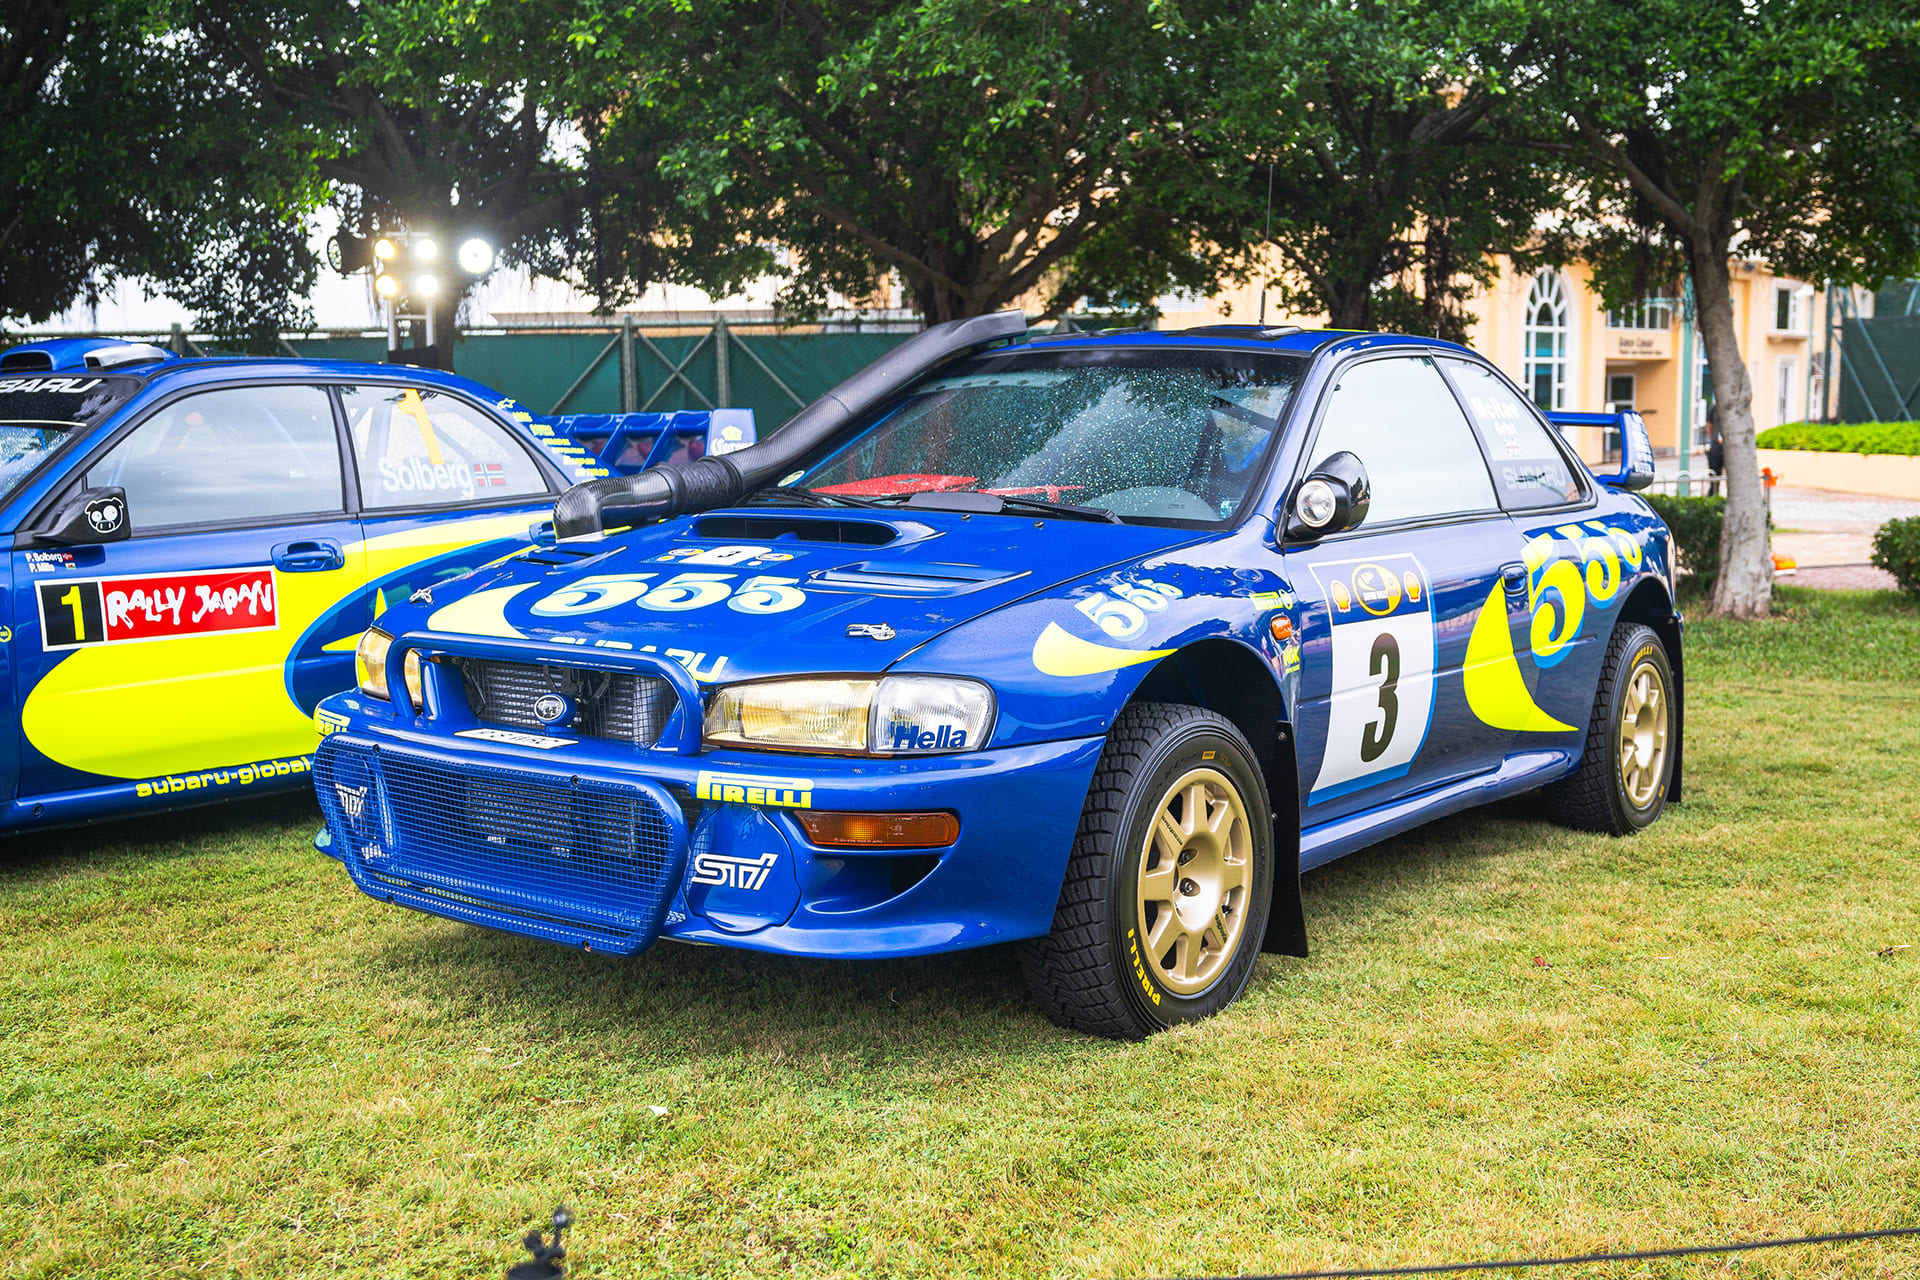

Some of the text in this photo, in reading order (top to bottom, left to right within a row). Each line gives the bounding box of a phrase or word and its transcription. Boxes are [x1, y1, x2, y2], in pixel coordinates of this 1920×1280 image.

[397, 388, 444, 465] 1
[379, 456, 475, 499] Solberg
[60, 579, 273, 641] 1 RALLY JAPAN
[530, 573, 807, 616] 555
[1073, 579, 1184, 642] 555
[1520, 520, 1643, 669] 555
[1360, 632, 1401, 763] 3
[893, 724, 967, 749] Hella
[696, 770, 815, 809] PIRELLI
